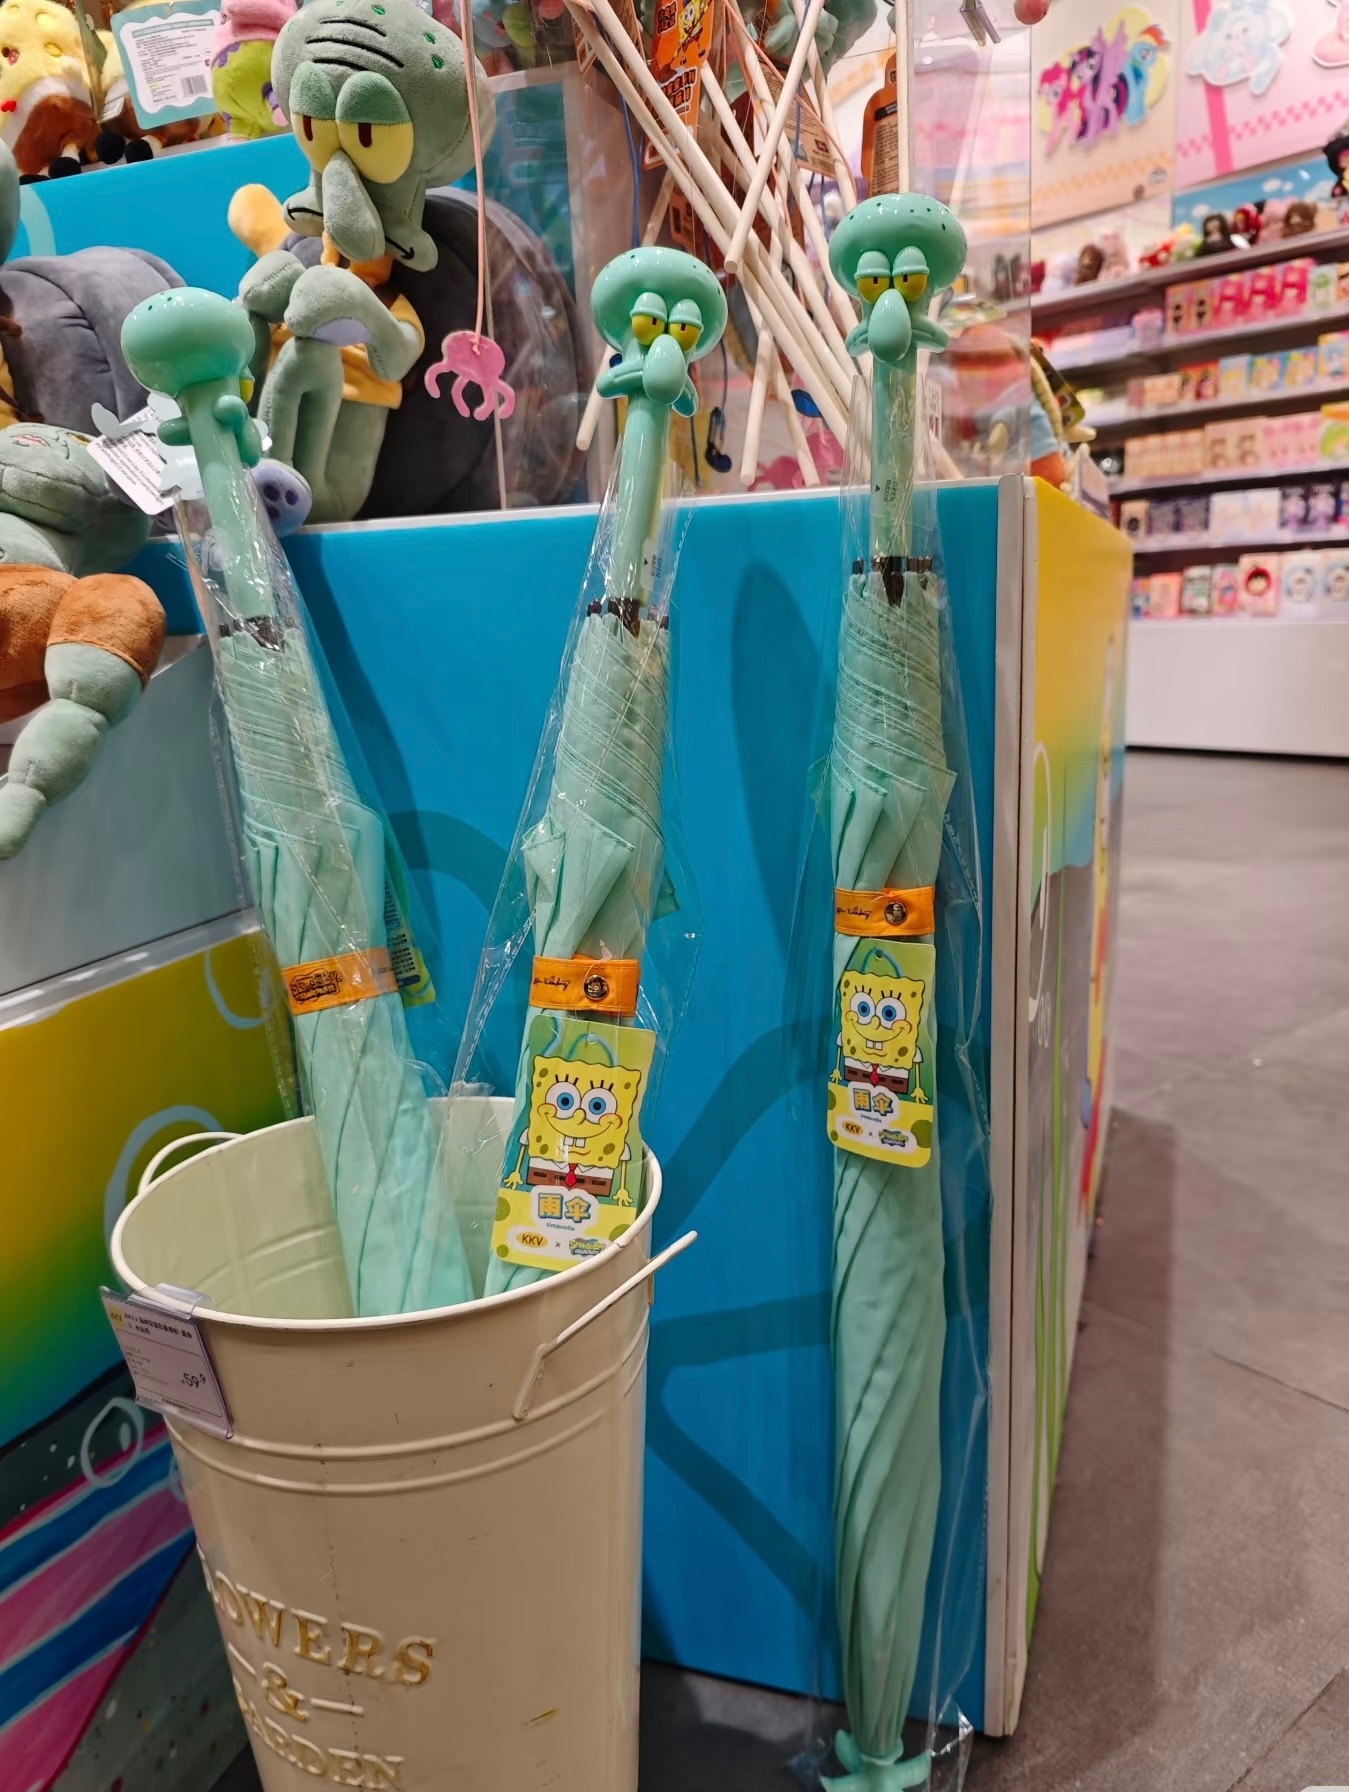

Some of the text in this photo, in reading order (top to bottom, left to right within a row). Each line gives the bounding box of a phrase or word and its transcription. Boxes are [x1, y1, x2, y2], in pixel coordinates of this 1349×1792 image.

[853, 1088, 894, 1116] 雨伞
[845, 1121, 861, 1134] KKV
[538, 1193, 591, 1223] 雨伞
[546, 1222, 575, 1232] Umbrella
[521, 1233, 544, 1247] KKV
